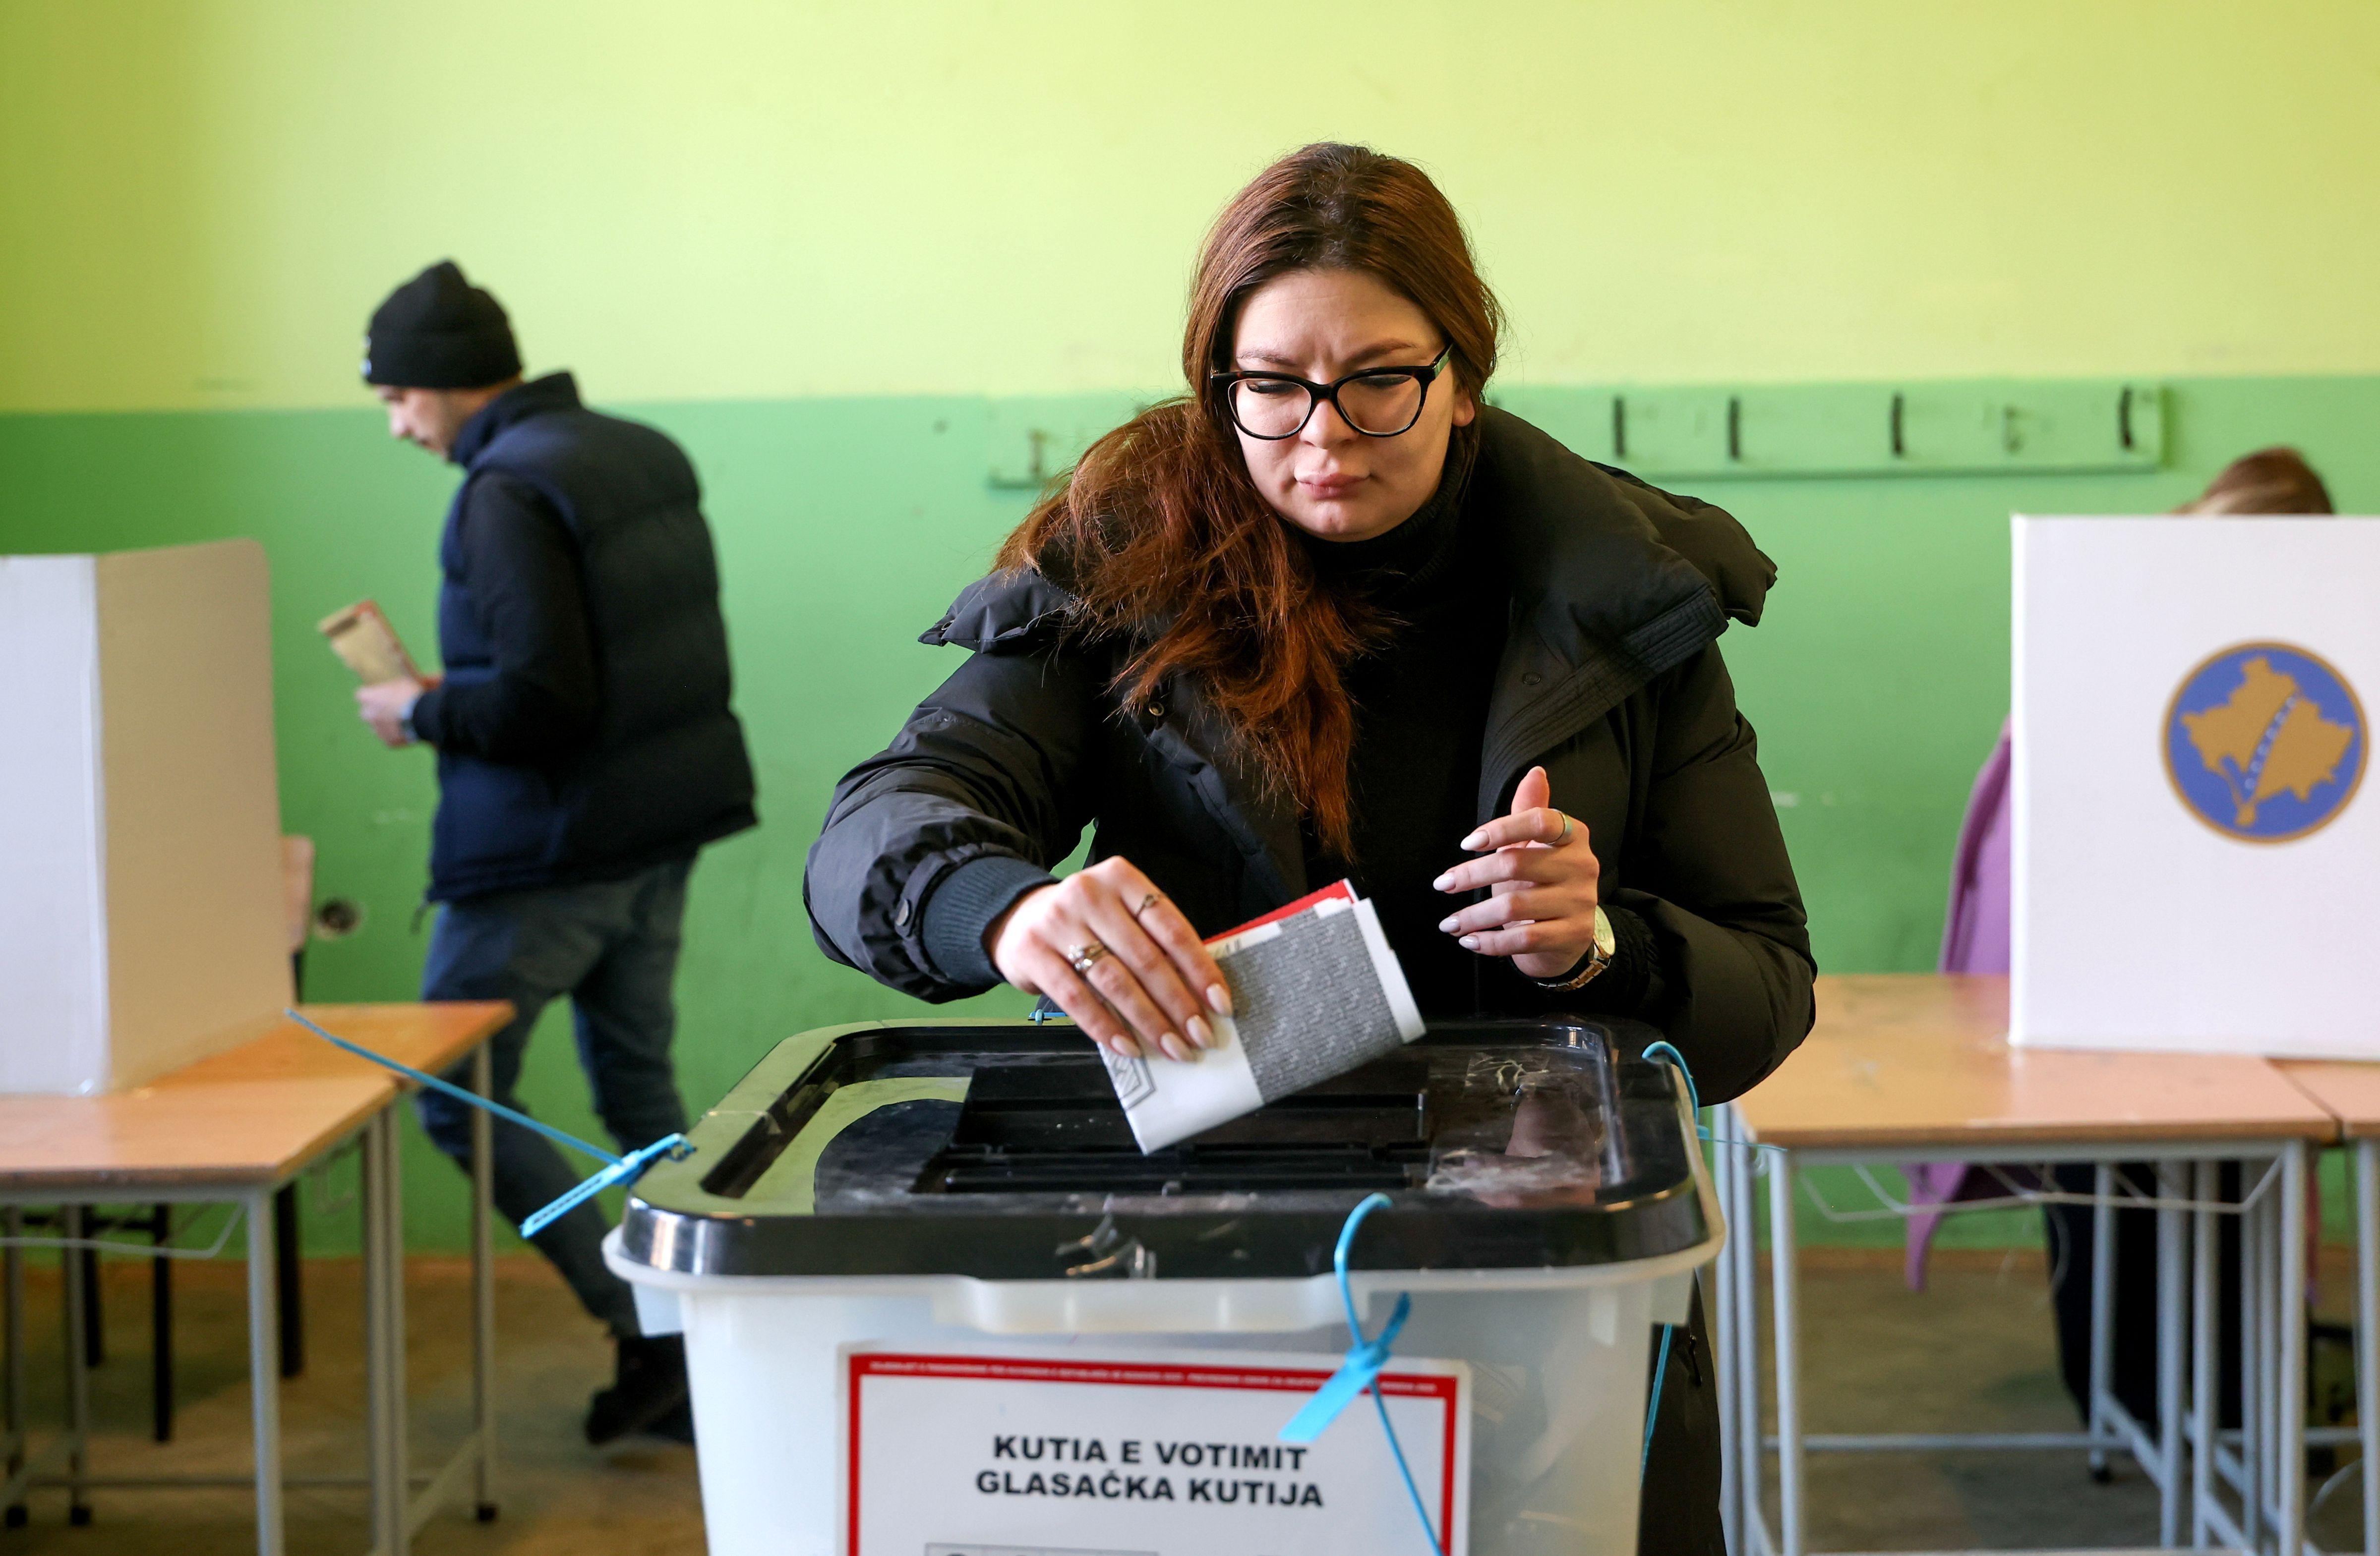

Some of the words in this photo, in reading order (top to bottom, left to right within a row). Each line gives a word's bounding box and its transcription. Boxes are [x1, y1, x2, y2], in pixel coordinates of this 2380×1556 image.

[994, 1436, 1107, 1463] KUTIA
[1121, 1441, 1141, 1464] E
[1155, 1441, 1308, 1471] VOTIMIT
[976, 1469, 1175, 1501] GLASAČKA
[1189, 1478, 1323, 1507] KUTIJA
